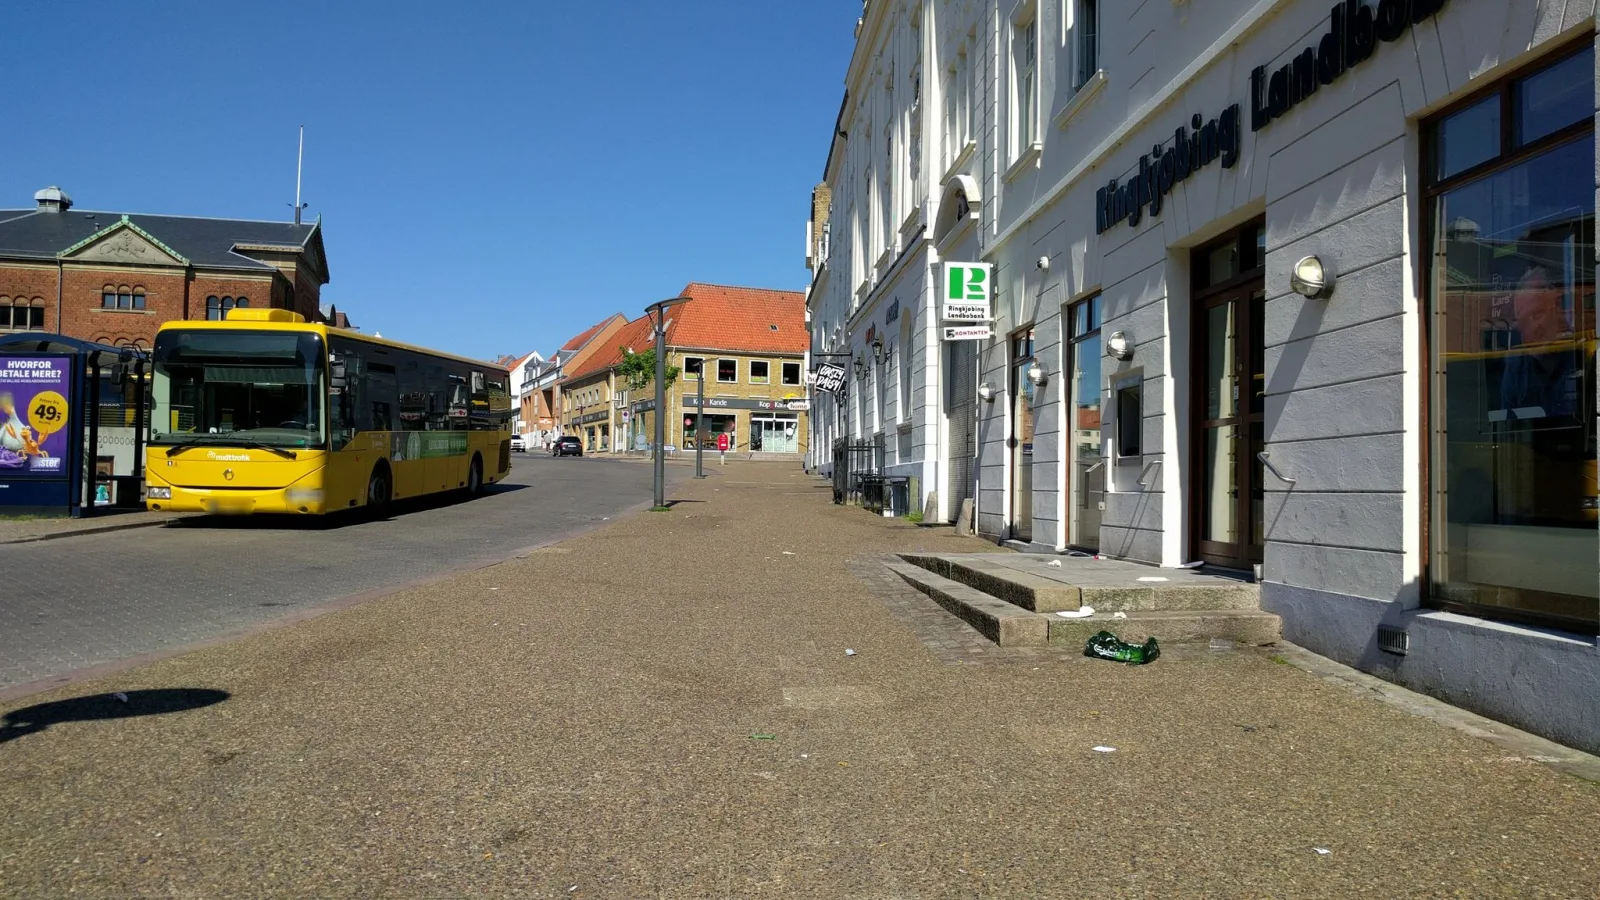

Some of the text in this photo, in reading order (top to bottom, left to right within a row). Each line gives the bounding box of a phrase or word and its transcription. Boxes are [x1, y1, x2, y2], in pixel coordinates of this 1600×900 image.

[1491, 307, 1501, 318] liv
[8, 360, 52, 369] HVORFOR
[32, 370, 62, 378] MERE?
[816, 375, 841, 391] DAISY
[709, 398, 728, 406] Kande
[758, 400, 771, 409] Kop
